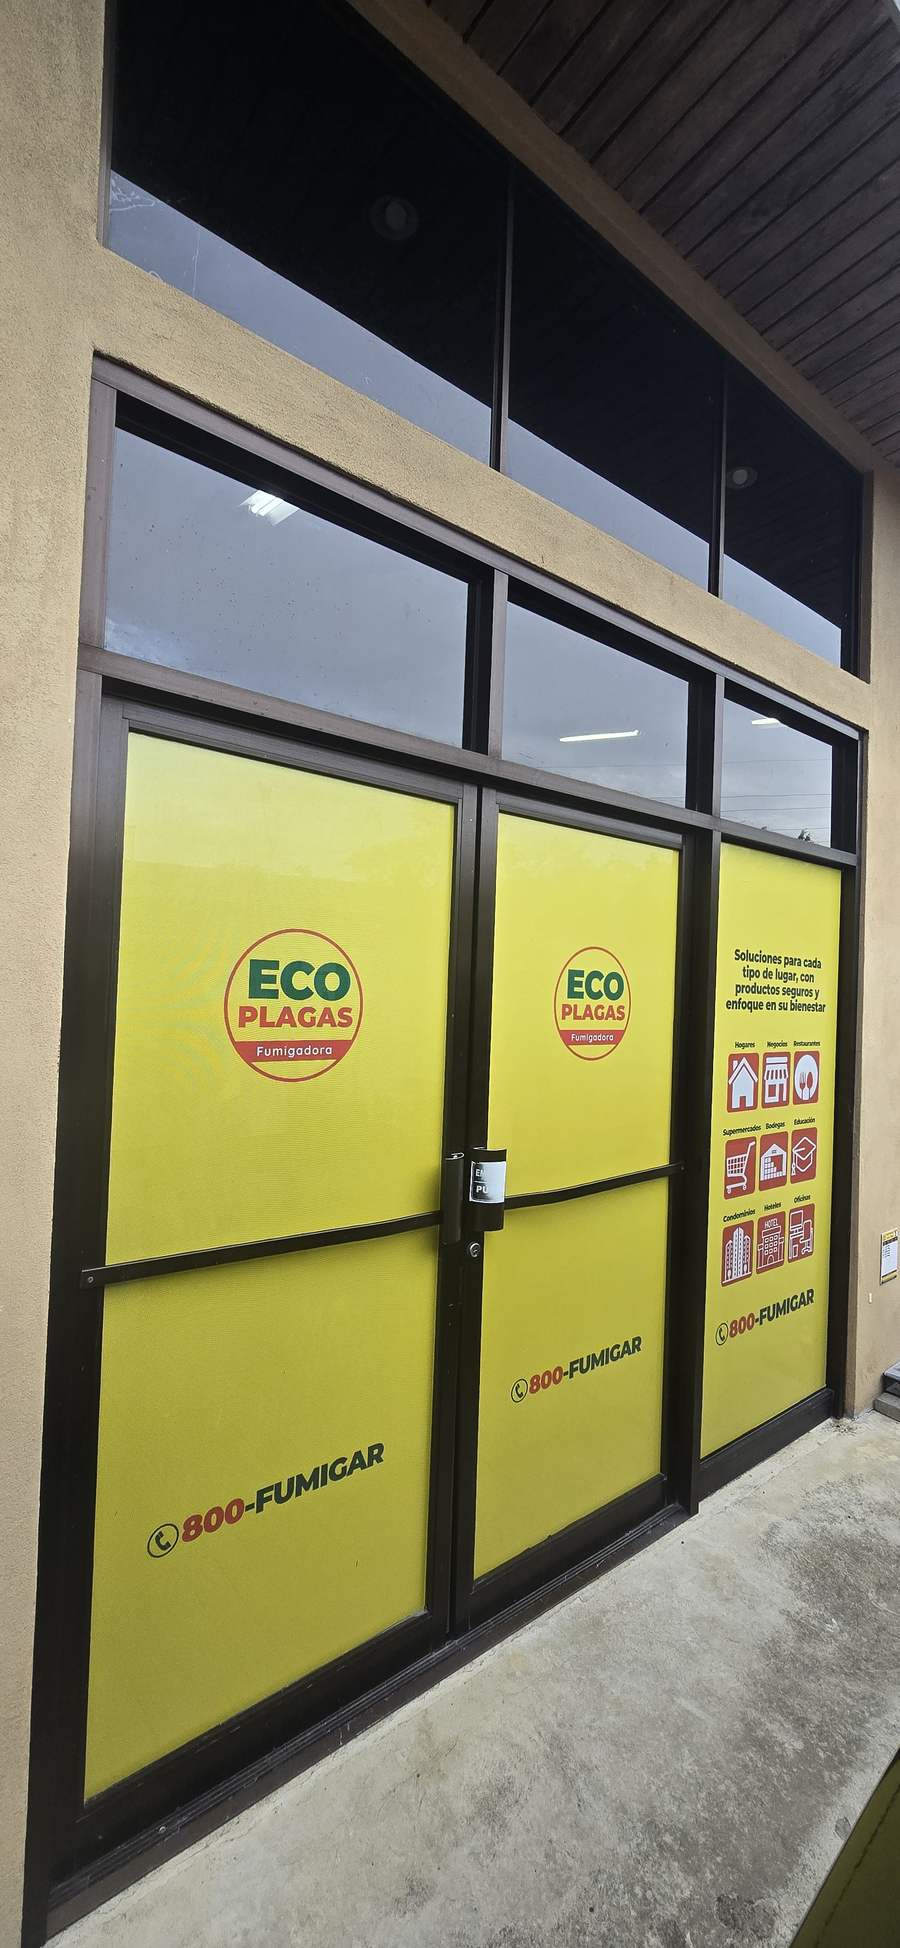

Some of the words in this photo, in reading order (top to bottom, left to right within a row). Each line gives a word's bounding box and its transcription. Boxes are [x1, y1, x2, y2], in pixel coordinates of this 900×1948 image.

[735, 949, 782, 965] Soluciones
[784, 956, 802, 968] para
[804, 958, 822, 969] cada
[248, 959, 351, 1001] ECO
[743, 965, 761, 981] tipo
[763, 968, 774, 980] de
[776, 969, 799, 984] lugar,
[801, 973, 815, 983] con
[567, 969, 625, 1001] ECO
[736, 983, 780, 997] productos
[782, 987, 814, 999] seguros
[814, 988, 820, 1000] y
[561, 1003, 625, 1021] PLAGAS
[726, 998, 764, 1013] enfoque
[766, 1002, 777, 1011] en
[779, 1002, 788, 1011] su
[790, 1000, 826, 1013] bienestar
[238, 1005, 353, 1028] PLAGAS
[571, 1033, 614, 1043] Fumigadora
[256, 1046, 333, 1058] Fumigadora
[766, 1122, 785, 1130] Bodegas
[794, 1117, 816, 1126] Educación
[723, 1125, 762, 1137] Supermercados
[764, 1202, 782, 1212] Hoteles
[794, 1195, 811, 1204] Oficinas
[724, 1209, 756, 1222] Condominios
[765, 1219, 779, 1229] HOTEL
[729, 1288, 815, 1338] 800-FUMIGAR
[528, 1336, 642, 1394] 800-FUMIGAR
[181, 1442, 385, 1543] 800-FUMIGAR
